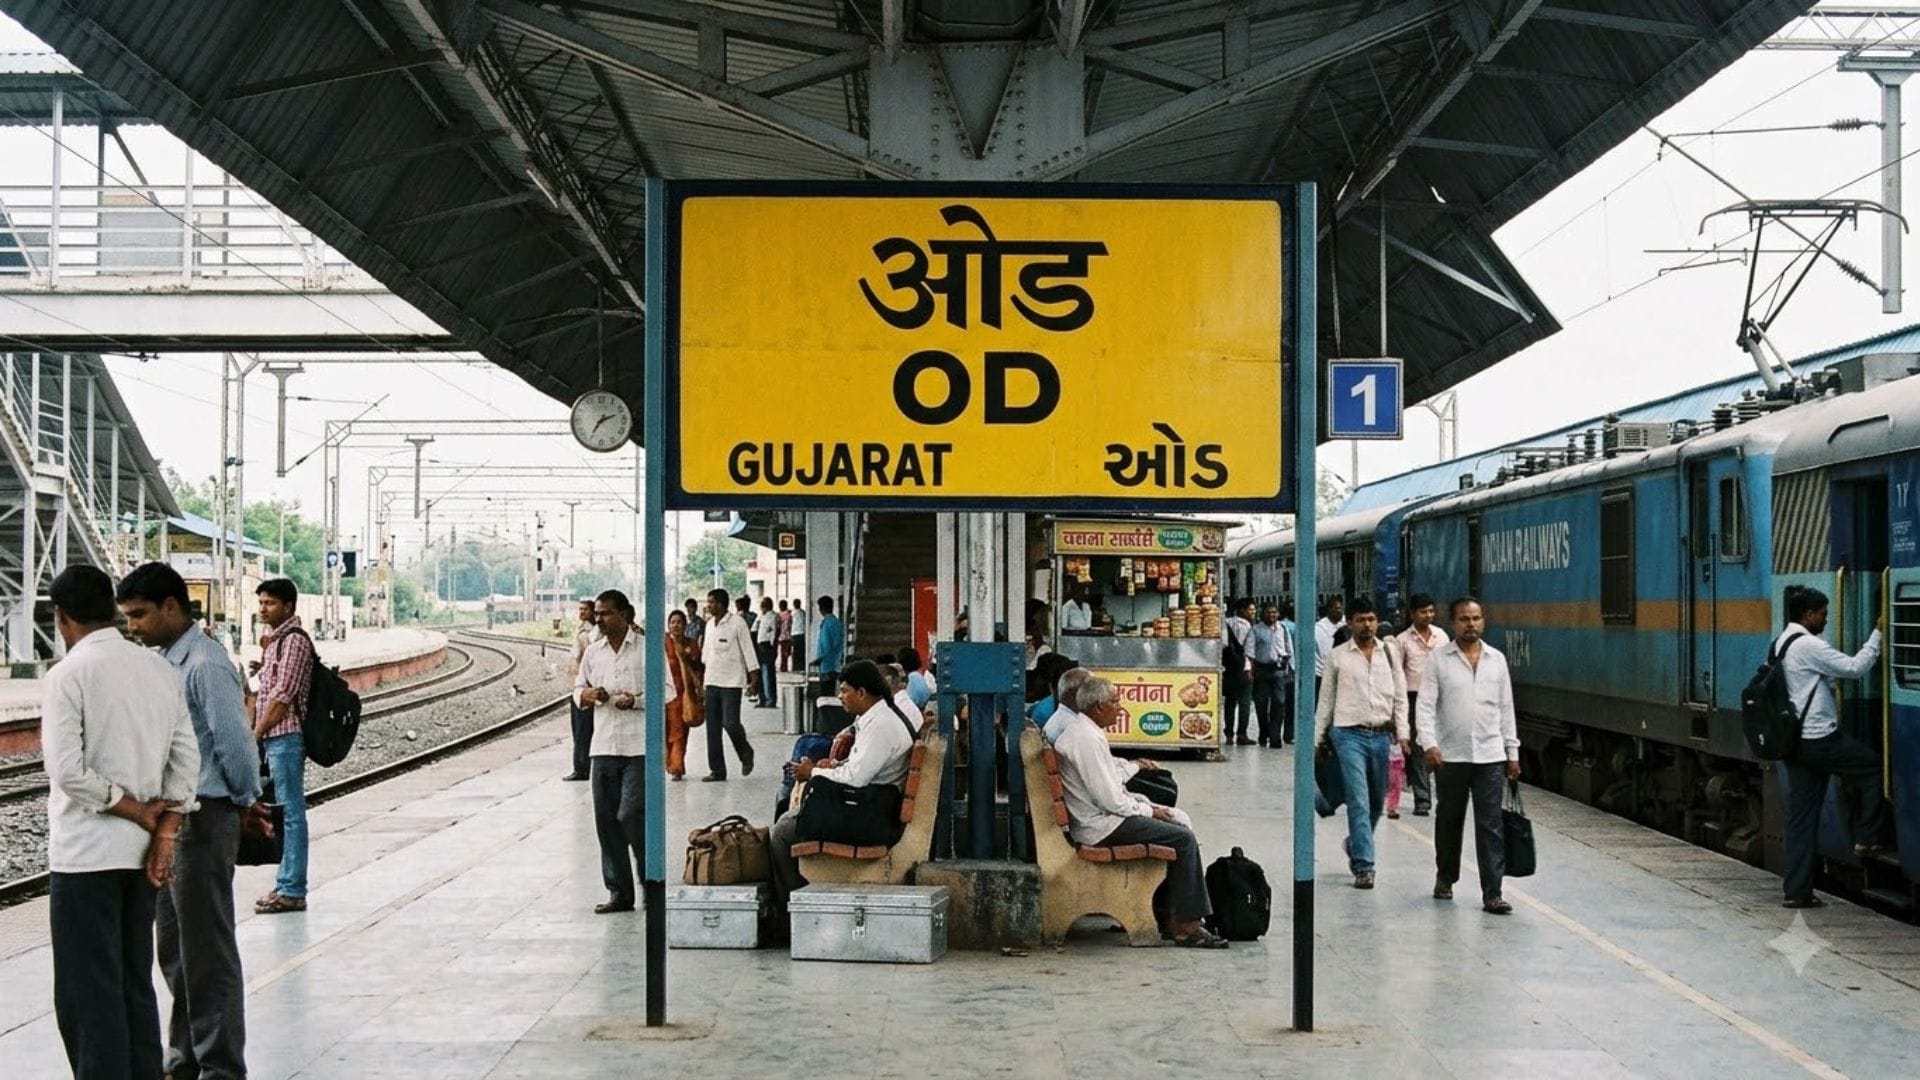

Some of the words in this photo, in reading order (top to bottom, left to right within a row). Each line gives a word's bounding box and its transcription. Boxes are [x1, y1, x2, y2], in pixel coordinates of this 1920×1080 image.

[859, 205, 1108, 331] ओड
[893, 350, 1060, 425] OD
[1351, 374, 1376, 425] 1
[729, 443, 952, 486] GUJARAT
[1104, 423, 1228, 488] ઓડ
[1515, 520, 1570, 571] RAILWAYS
